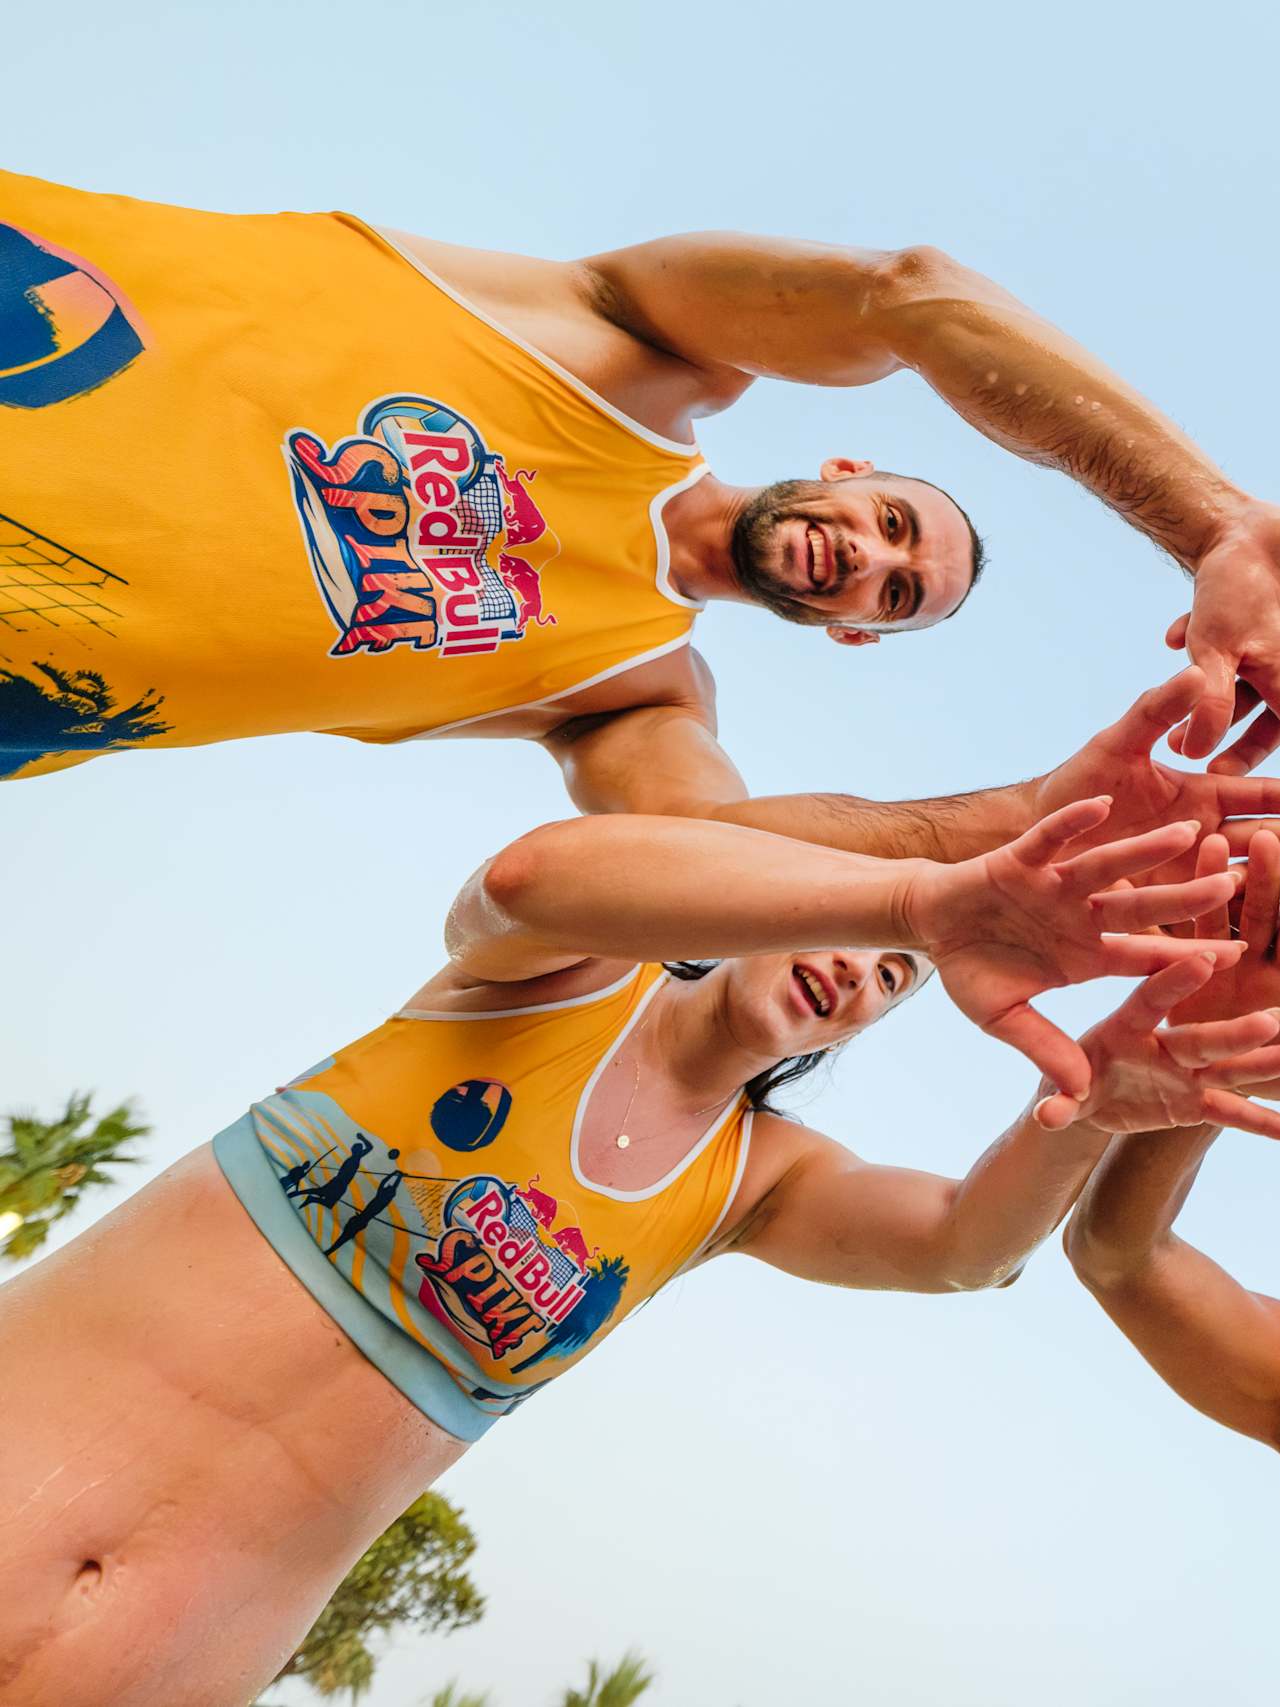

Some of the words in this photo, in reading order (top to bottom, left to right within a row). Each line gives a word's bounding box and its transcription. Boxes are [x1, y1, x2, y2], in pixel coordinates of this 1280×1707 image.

[291, 434, 438, 654] SPIKE
[403, 432, 480, 549] Red
[422, 556, 499, 655] Bull
[416, 1229, 546, 1359] SPIKE
[465, 1190, 535, 1269] Red
[514, 1255, 583, 1322] Bull
